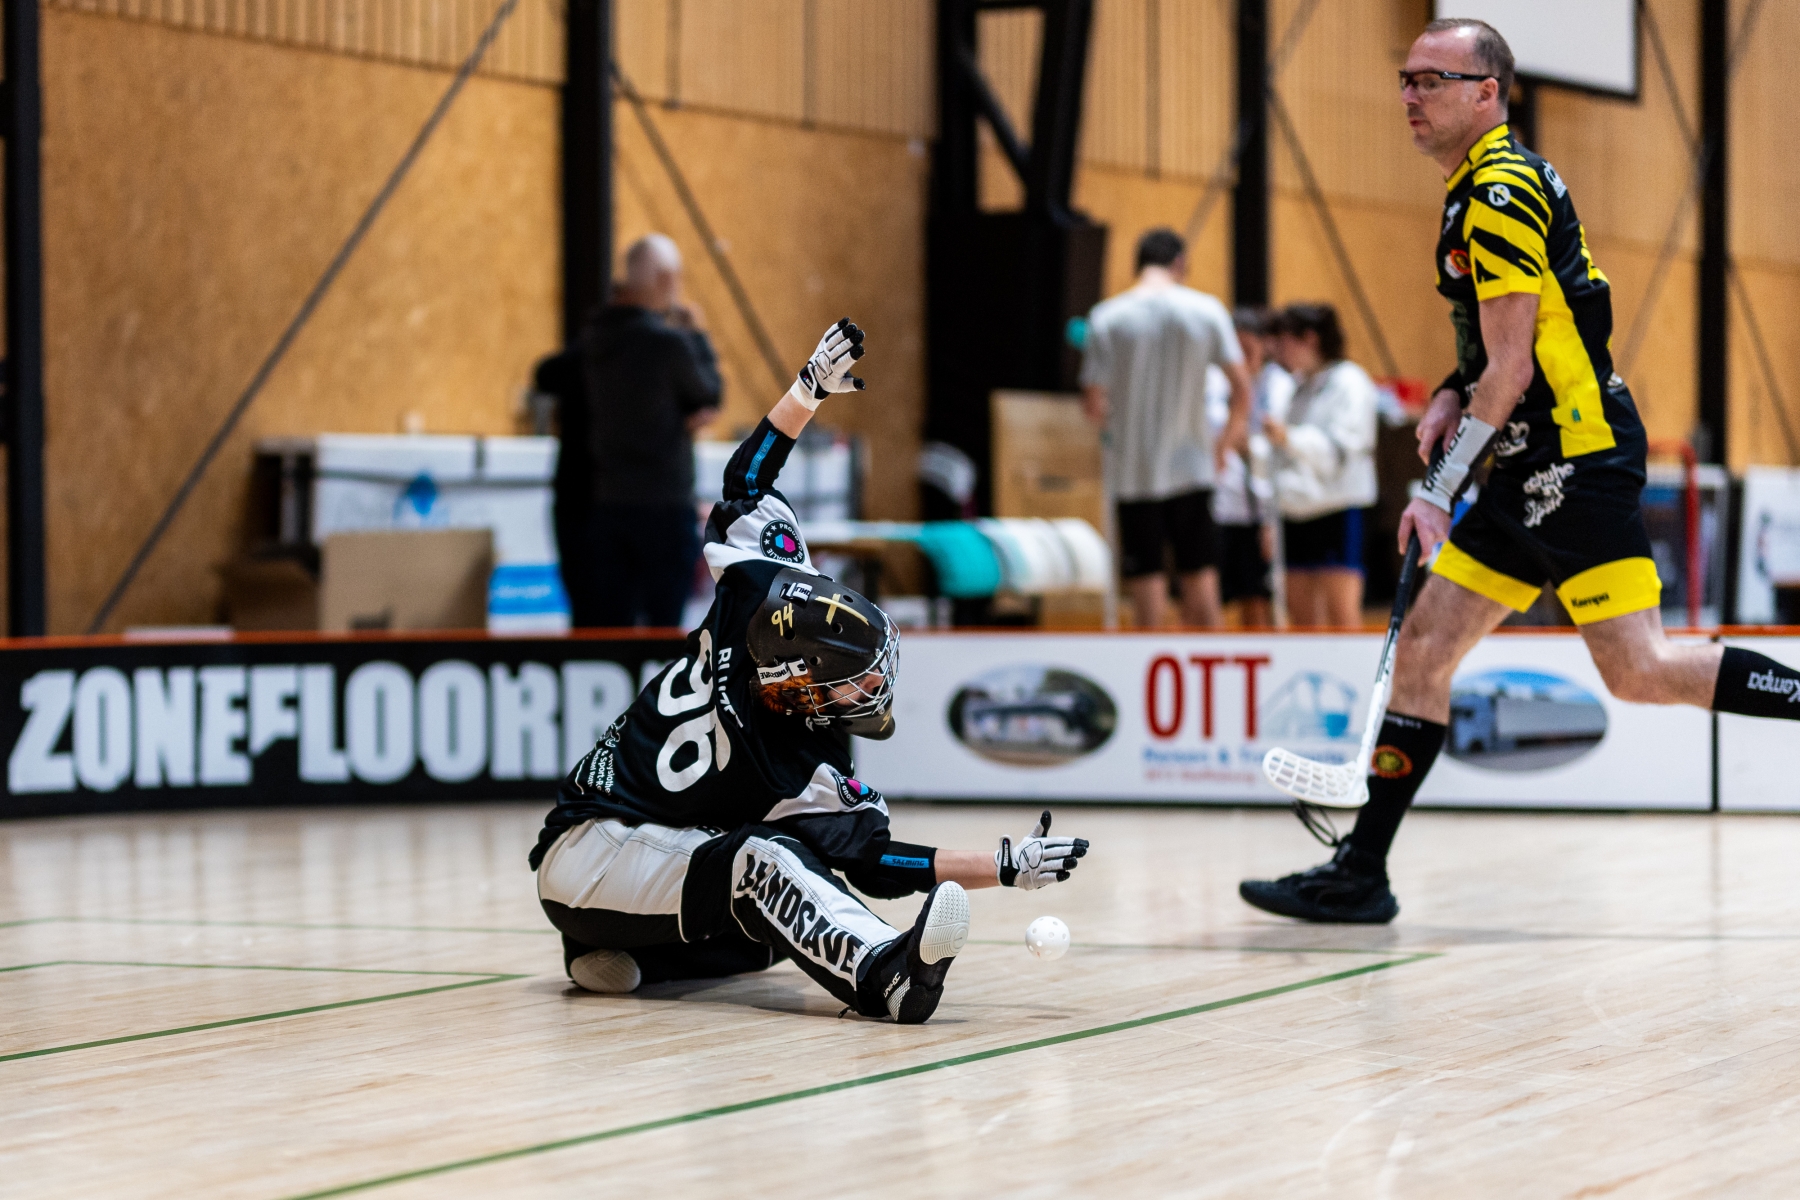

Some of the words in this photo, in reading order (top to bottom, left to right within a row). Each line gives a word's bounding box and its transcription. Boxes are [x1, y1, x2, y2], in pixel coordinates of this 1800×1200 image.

[771, 602, 794, 636] 94
[656, 629, 732, 793] 96
[1144, 654, 1271, 741] OTT
[892, 858, 925, 867] SALMING
